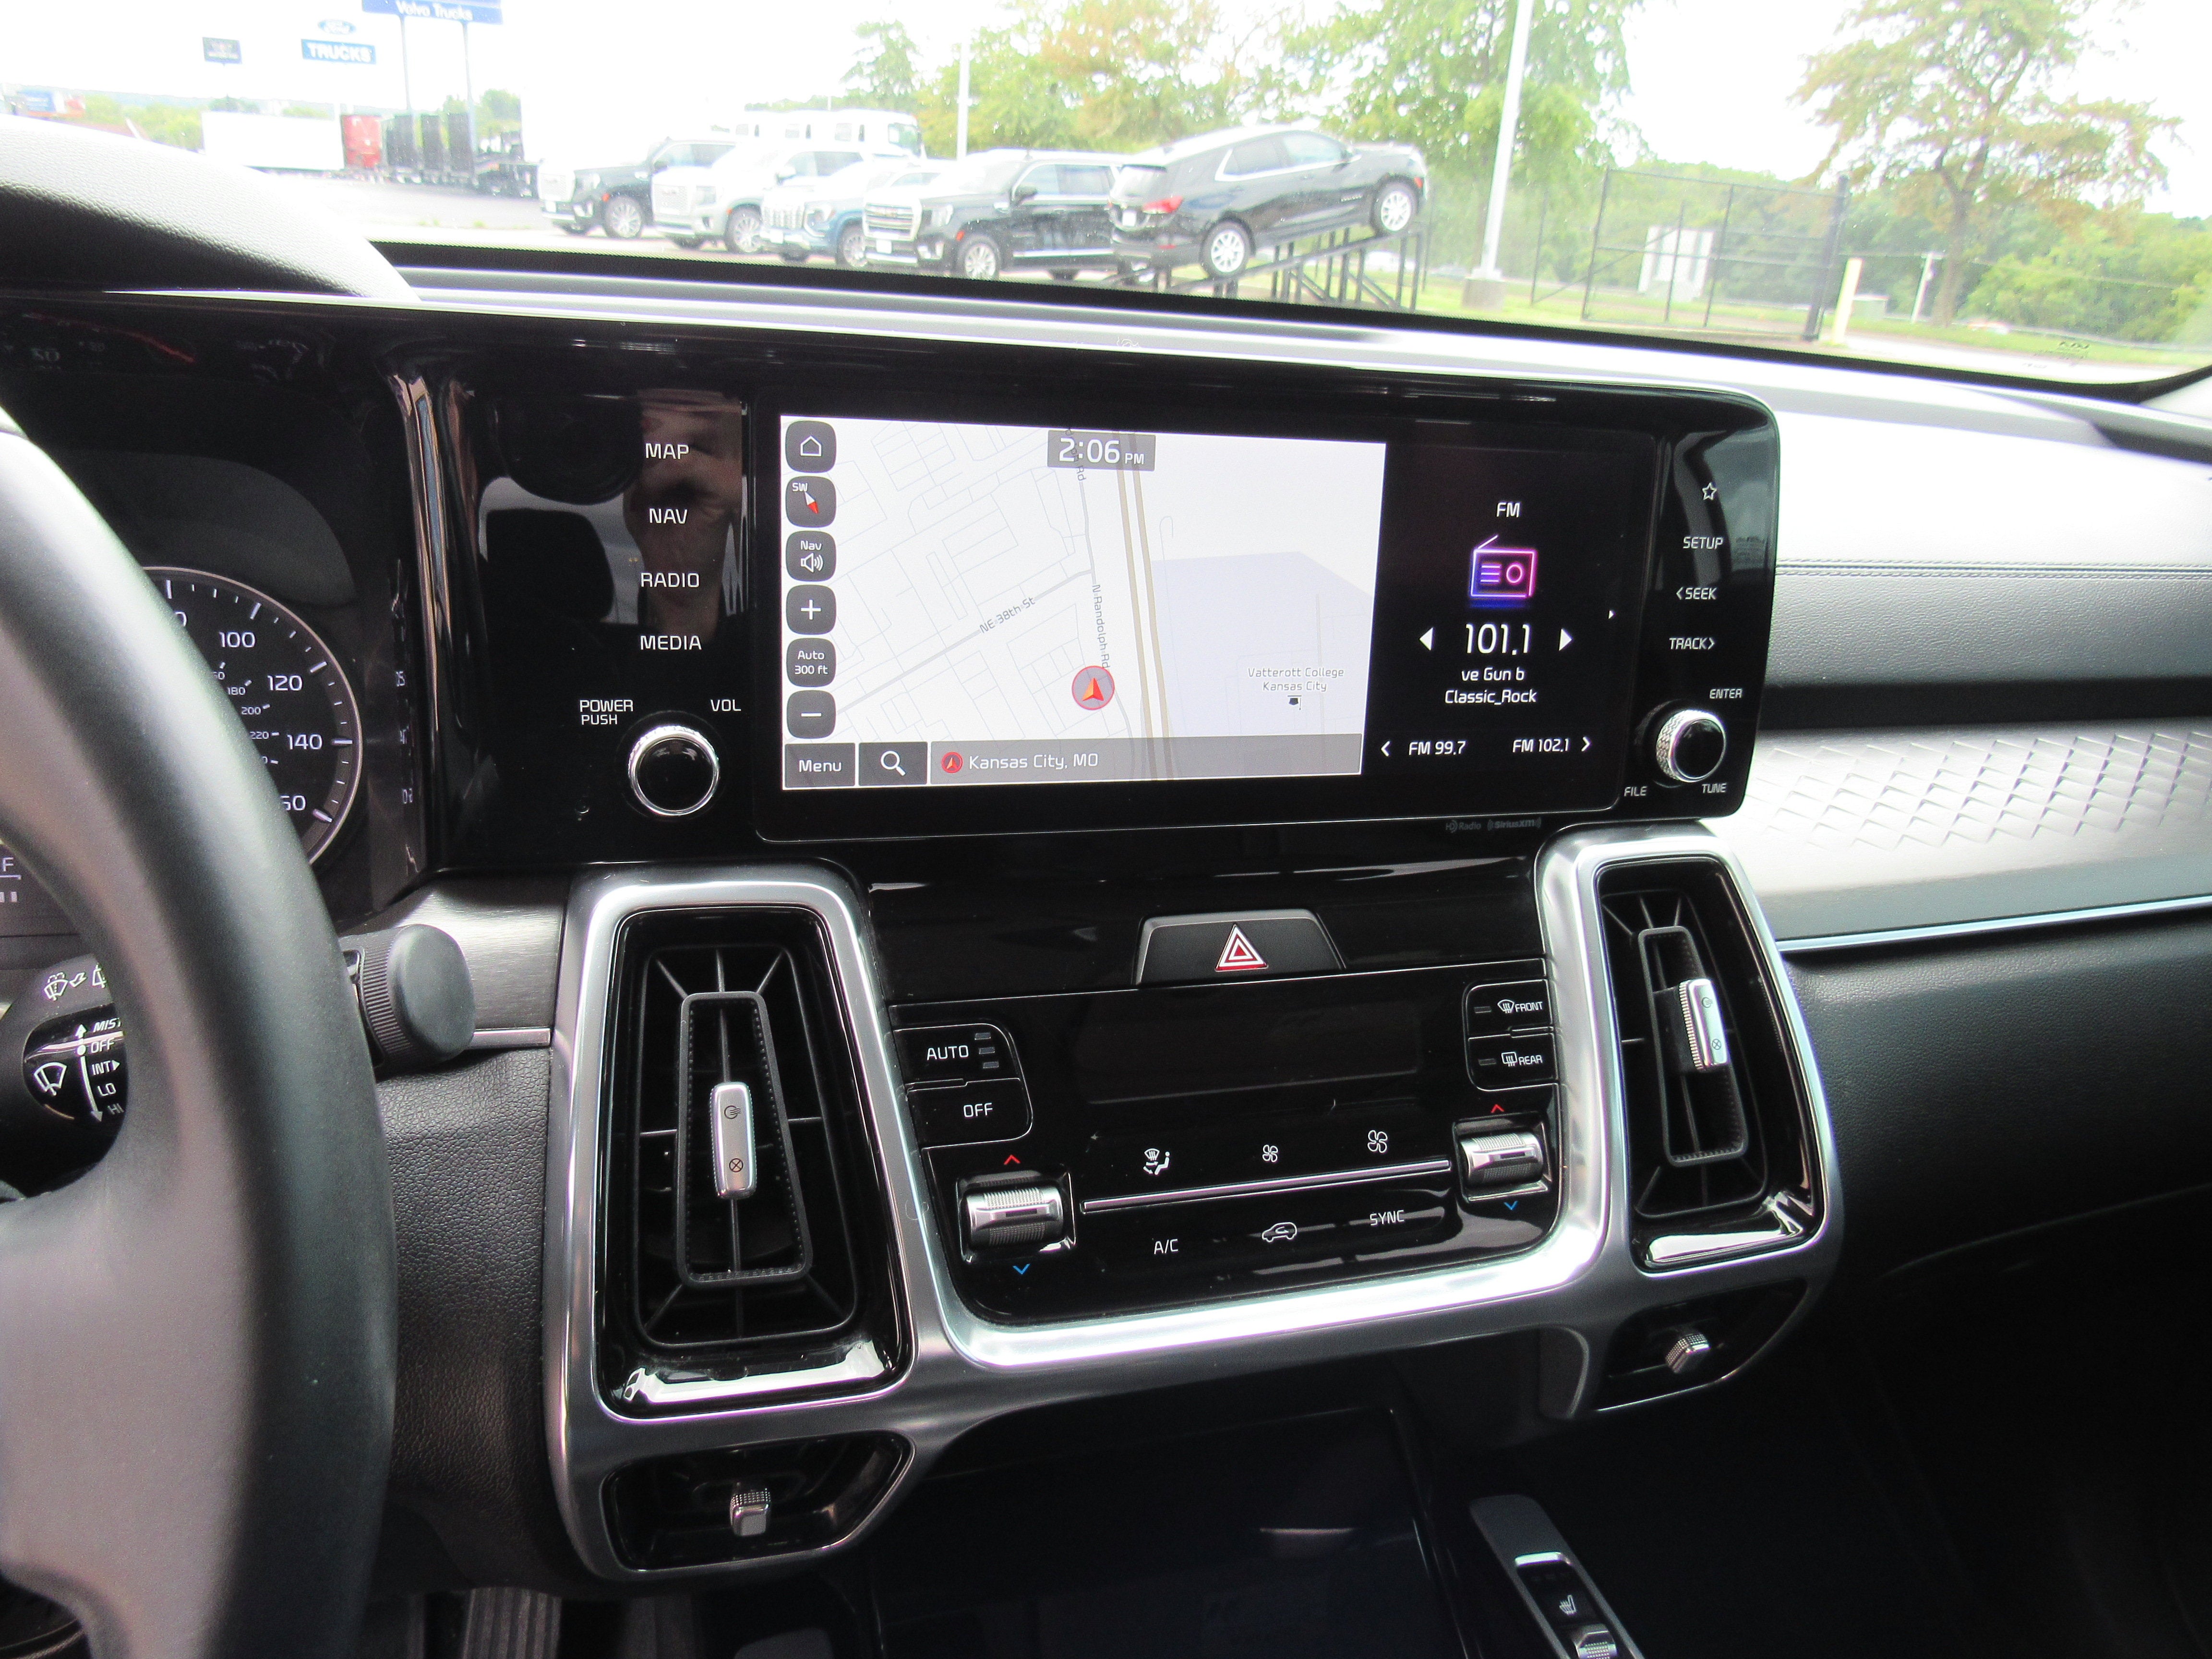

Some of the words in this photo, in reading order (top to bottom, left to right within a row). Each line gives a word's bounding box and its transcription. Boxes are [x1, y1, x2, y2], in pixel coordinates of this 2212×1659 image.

[395, 1, 431, 16] Volvo
[434, 4, 473, 20] Trucks
[307, 42, 372, 63] TRUCKS
[645, 443, 689, 459] MAP
[1059, 438, 1120, 464] 2:06
[1125, 453, 1144, 465] PM
[792, 482, 808, 492] SW
[649, 508, 687, 524] NAV
[1496, 502, 1520, 517] FM
[800, 541, 822, 551] Nav
[1683, 537, 1723, 550] SETUP
[641, 573, 699, 588] RADIO
[1685, 588, 1717, 600] SEEK
[980, 616, 996, 633] NE
[996, 606, 1022, 625] 38th
[1022, 596, 1036, 608] St
[1094, 596, 1107, 650] Randolph
[1101, 654, 1110, 668] Rd
[219, 632, 256, 648] 100
[640, 636, 702, 650] MEDIA
[1466, 624, 1531, 655] 101.1
[1670, 637, 1707, 649] TRACK
[798, 650, 825, 660] Auto
[794, 665, 815, 675] 300
[818, 665, 828, 675] ft
[1248, 668, 1301, 677] Vatterott
[1305, 668, 1344, 678] College
[1461, 671, 1479, 681] ve
[1483, 667, 1511, 681] Gun
[1516, 667, 1525, 681] b
[267, 675, 302, 691] 120
[1263, 682, 1302, 691] Kansas
[1306, 681, 1327, 692] City
[228, 687, 246, 696] 180
[1445, 689, 1537, 705] Classic_Rock
[1709, 689, 1743, 699] ENTER
[579, 699, 633, 712] POWER
[711, 699, 741, 712] VOL
[581, 714, 618, 725] PUSH
[287, 734, 323, 750] 140
[1409, 742, 1430, 755] FM
[1435, 741, 1466, 755] 99.7
[1513, 739, 1533, 752] FM
[1539, 738, 1570, 752] 102.1
[799, 759, 842, 772] Menu
[969, 755, 1028, 769] Kansas
[1034, 754, 1068, 770] City,
[1073, 753, 1098, 767] MO
[1624, 786, 1647, 797] FILE
[1702, 783, 1727, 793] TUNE
[1459, 821, 1481, 830] Radio
[2, 857, 14, 872] F
[1515, 1001, 1543, 1012] FRONT
[91, 1038, 115, 1053] OFF
[927, 1045, 969, 1060] AUTO
[1519, 1054, 1543, 1066] REAR
[92, 1060, 110, 1075] INT
[97, 1083, 116, 1096] LO
[108, 1104, 124, 1115] HI
[963, 1103, 993, 1118] OFF
[1370, 1210, 1405, 1226] SYNC
[1154, 1238, 1178, 1254] A/C
